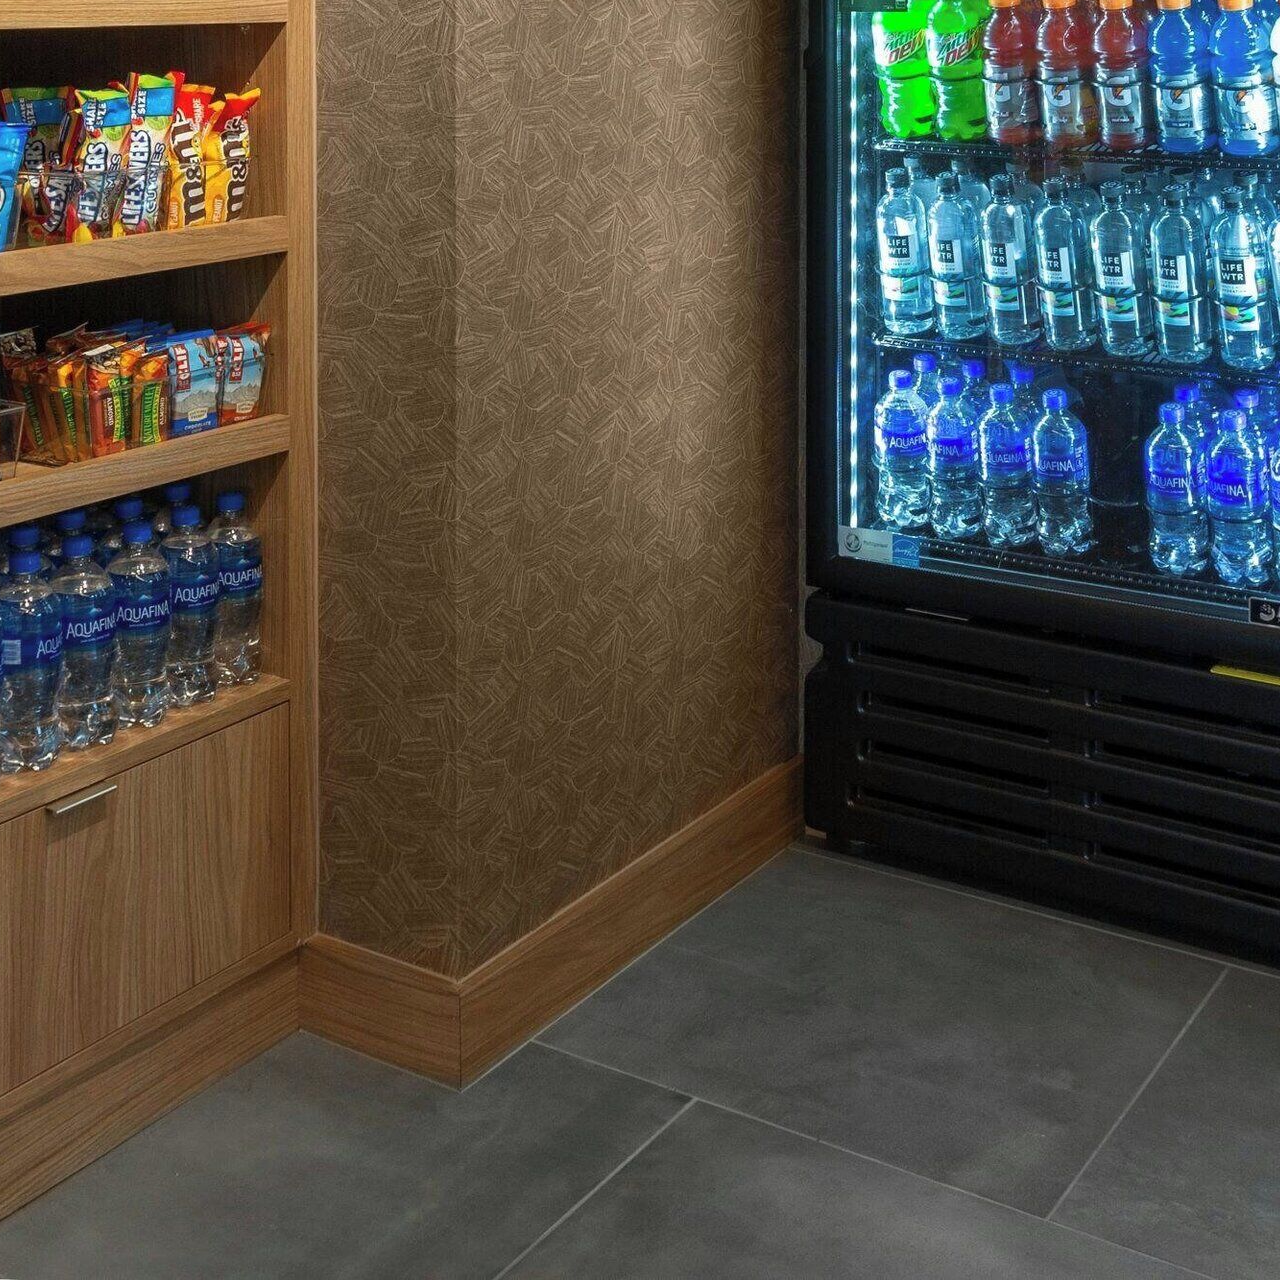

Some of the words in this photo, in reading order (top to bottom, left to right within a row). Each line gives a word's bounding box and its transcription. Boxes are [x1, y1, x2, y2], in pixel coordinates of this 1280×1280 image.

[97, 102, 107, 126] SIZE
[137, 90, 147, 114] SIZE
[145, 142, 166, 214] GUMMIES
[888, 237, 907, 247] LIFE
[889, 247, 909, 256] WTR
[1220, 263, 1243, 273] LIFE
[1221, 272, 1245, 282] WTR
[889, 433, 927, 448] AQUAFIN
[174, 580, 220, 604] AQUAFINA
[116, 600, 169, 624] AQUAFINA
[66, 613, 117, 639] AQUAFINA
